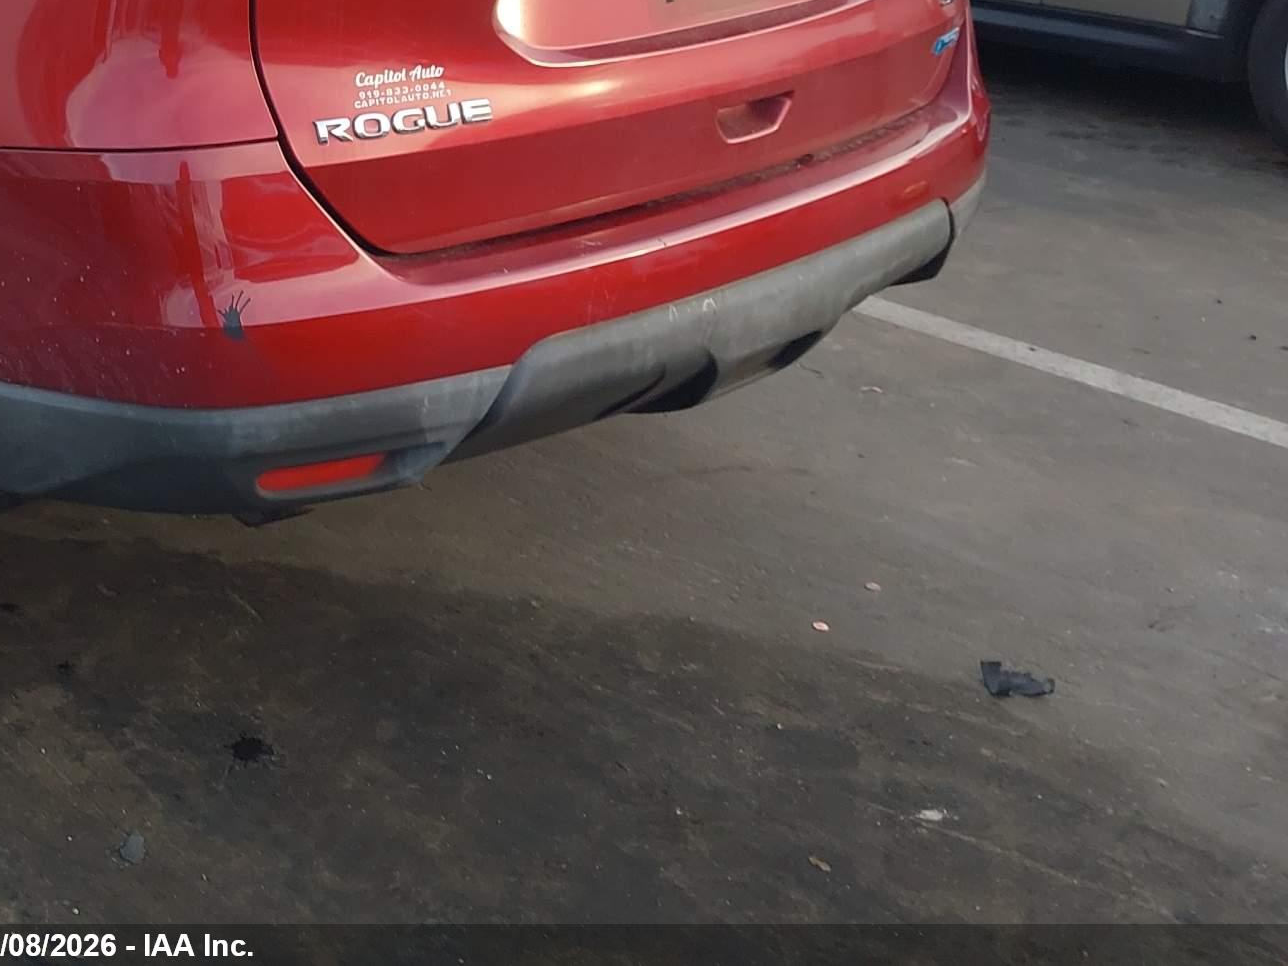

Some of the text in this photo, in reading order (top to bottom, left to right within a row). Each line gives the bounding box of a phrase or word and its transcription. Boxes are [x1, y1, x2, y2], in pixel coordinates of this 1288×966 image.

[355, 64, 445, 89] Capitol Auto
[313, 98, 494, 145] ROGUE
